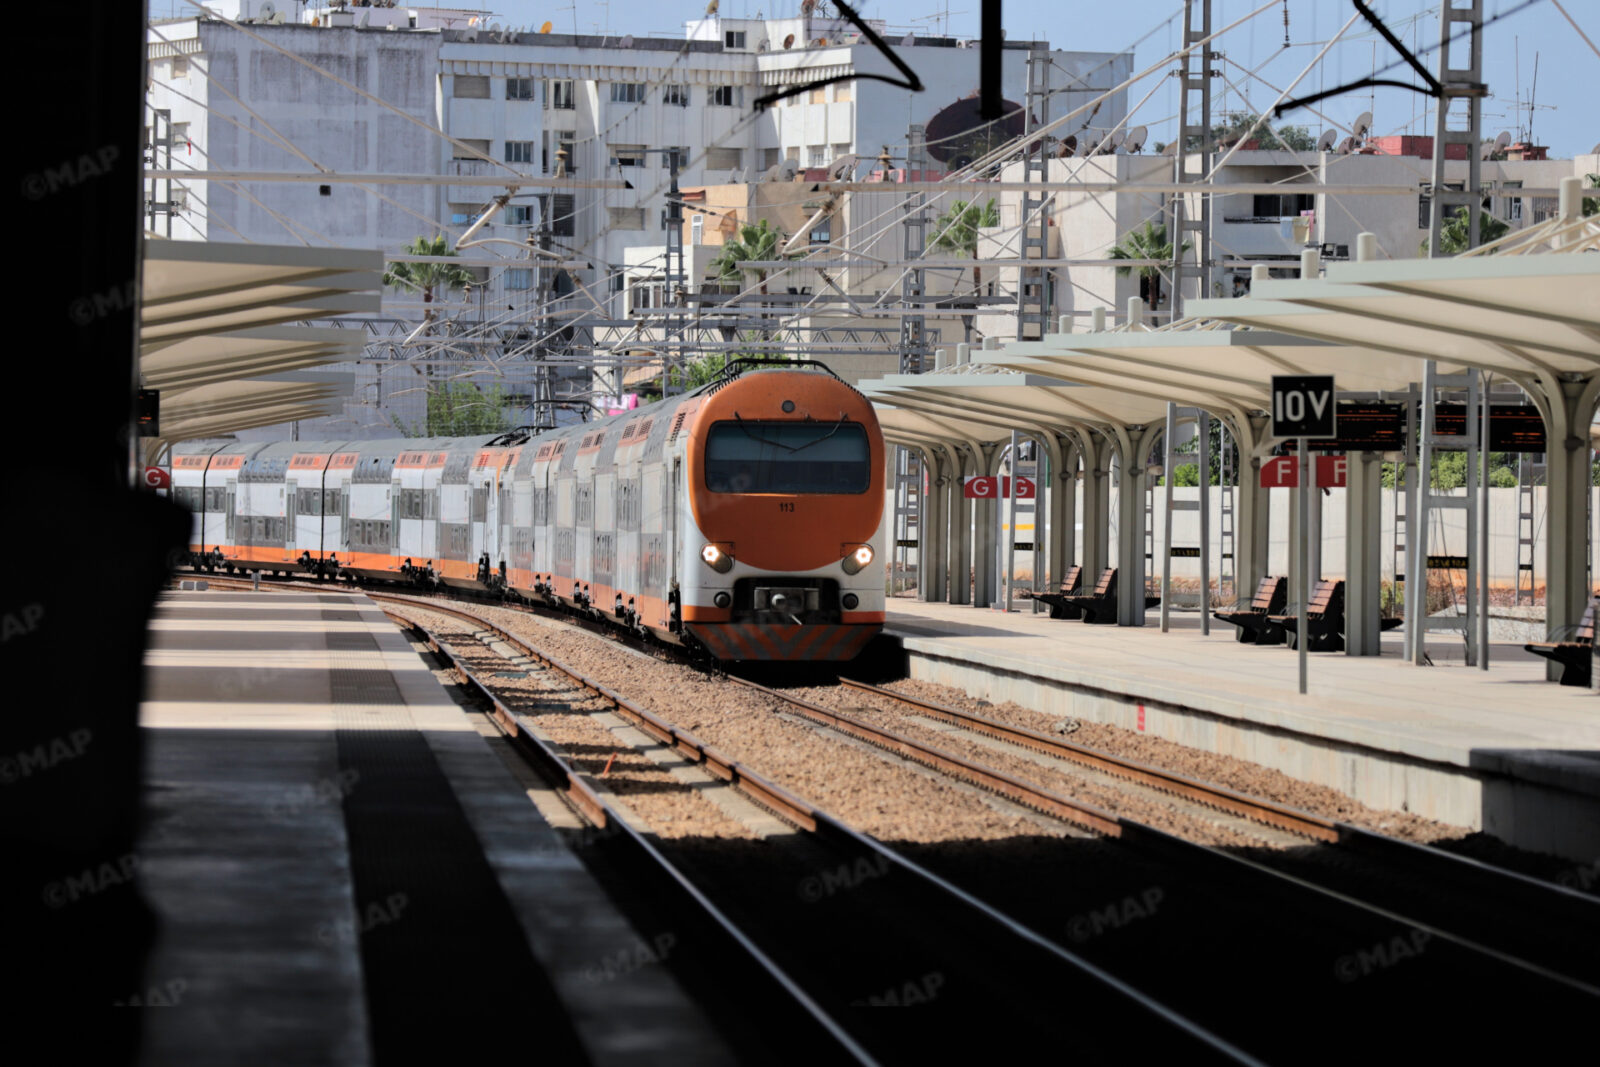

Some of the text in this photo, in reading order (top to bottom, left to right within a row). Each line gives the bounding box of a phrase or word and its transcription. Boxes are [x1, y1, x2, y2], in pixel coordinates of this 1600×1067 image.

[145, 469, 161, 486] G
[1277, 460, 1291, 484] F
[972, 478, 989, 496] G
[779, 503, 795, 512] 113
